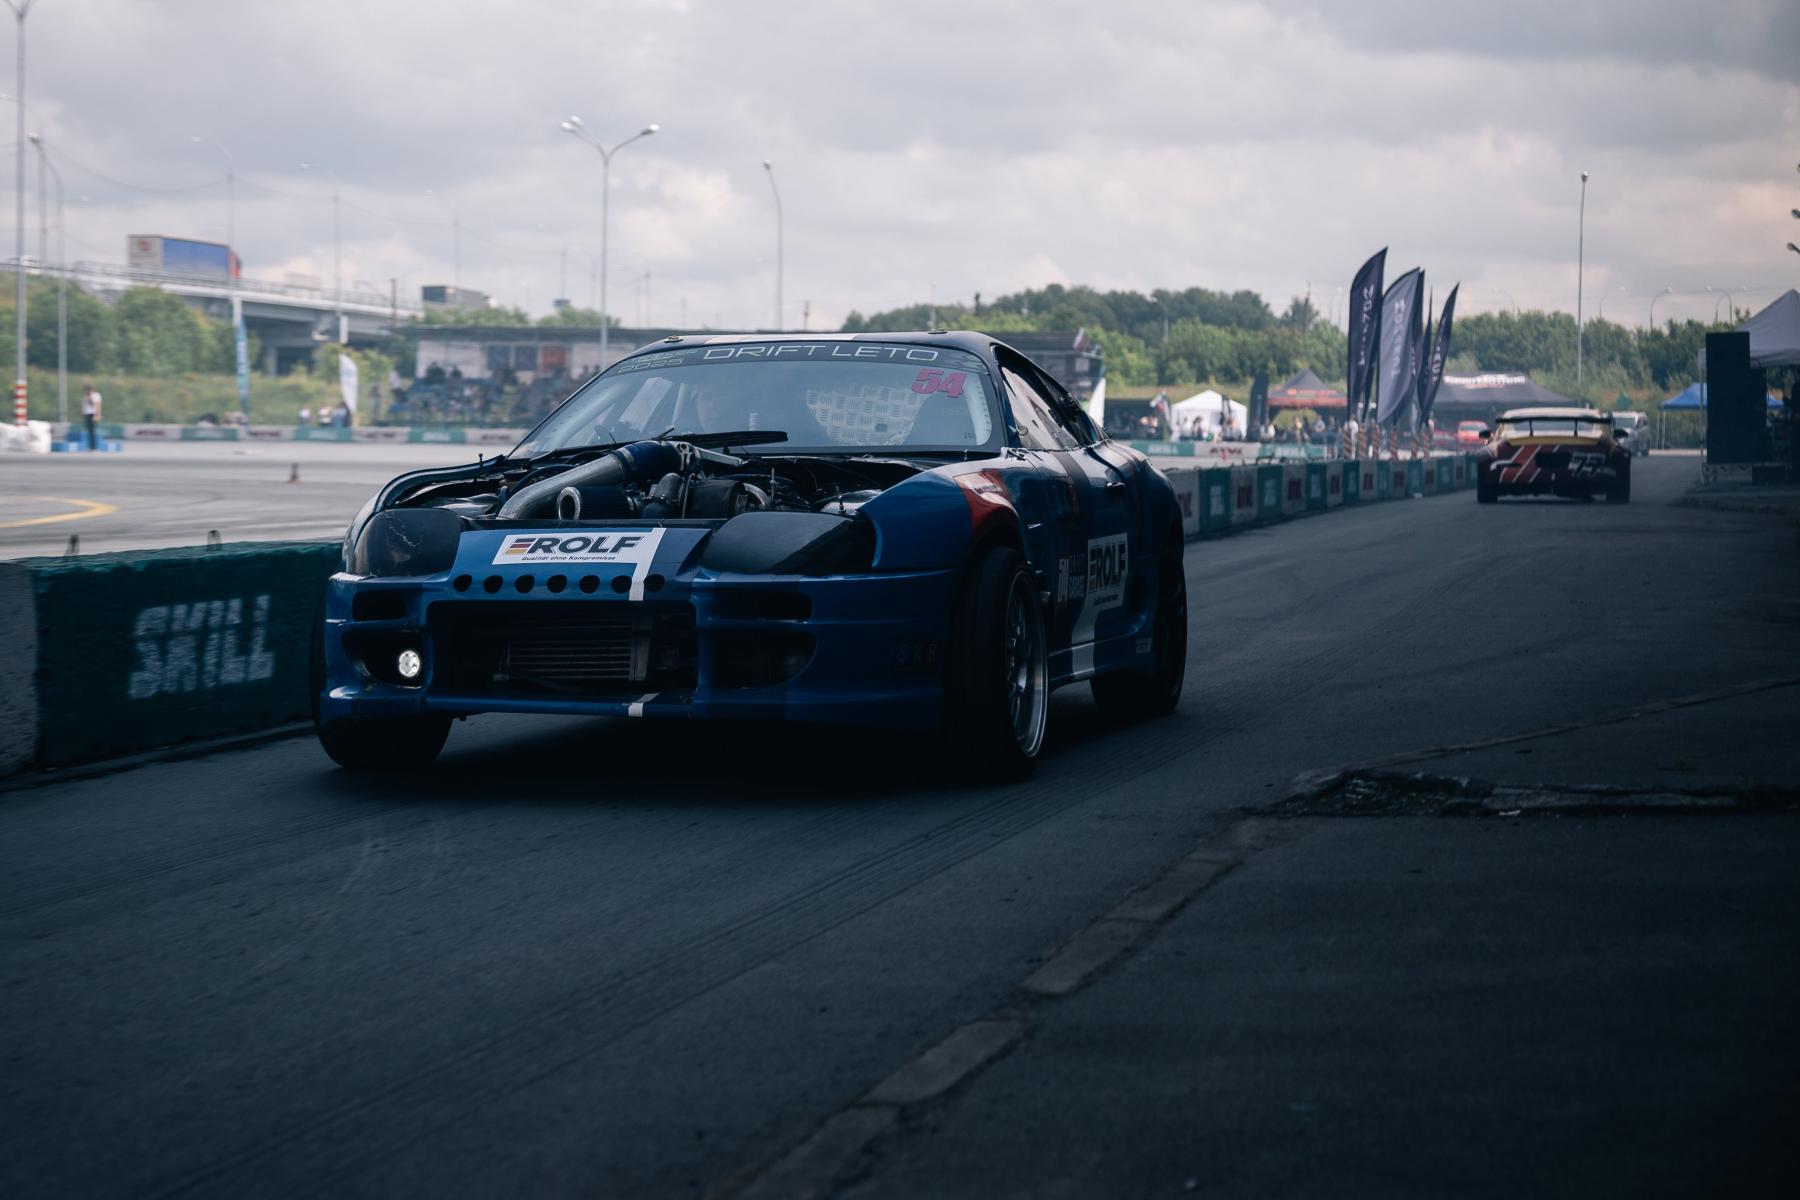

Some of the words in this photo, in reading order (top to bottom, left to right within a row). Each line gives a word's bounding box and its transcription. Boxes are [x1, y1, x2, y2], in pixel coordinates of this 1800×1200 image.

[703, 345, 826, 360] DRIFT
[832, 346, 939, 361] LETO
[911, 368, 967, 398] 54
[527, 536, 644, 554] ROLF
